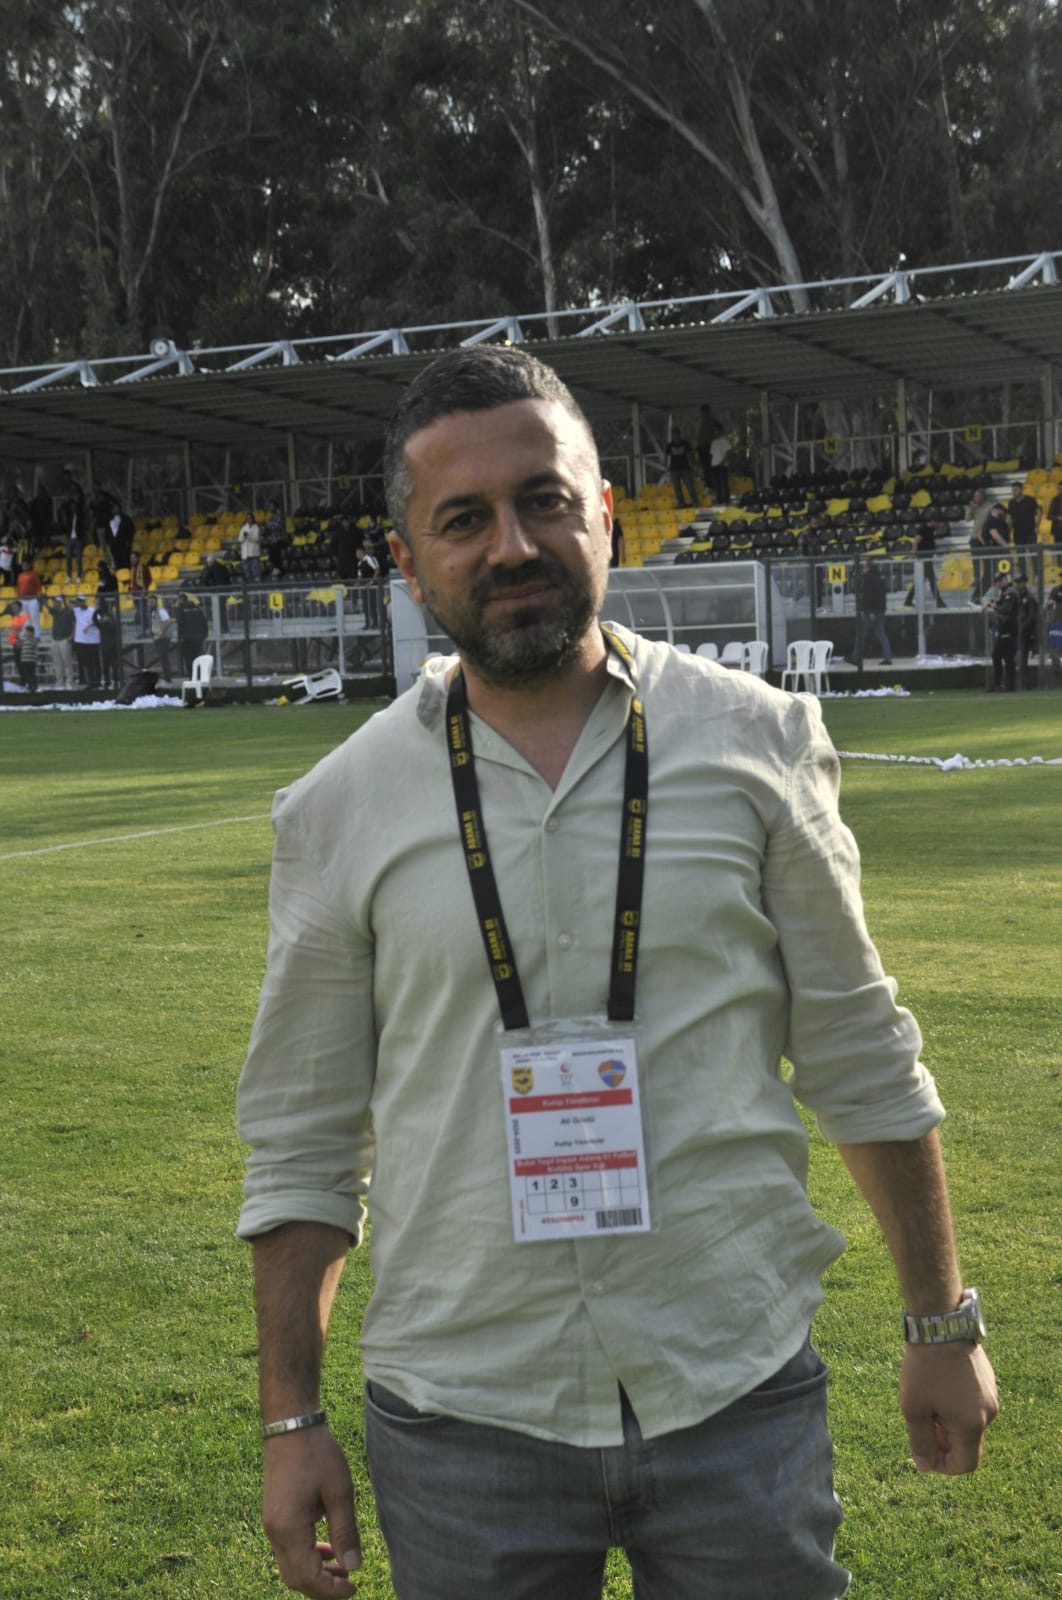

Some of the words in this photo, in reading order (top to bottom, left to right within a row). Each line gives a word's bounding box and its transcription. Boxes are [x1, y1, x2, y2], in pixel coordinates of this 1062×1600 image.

[832, 567, 842, 580] N
[624, 930, 636, 960] ADANA
[532, 1180, 539, 1190] 1
[550, 1179, 559, 1190] 2
[569, 1178, 577, 1188] 3
[570, 1196, 579, 1207] 9
